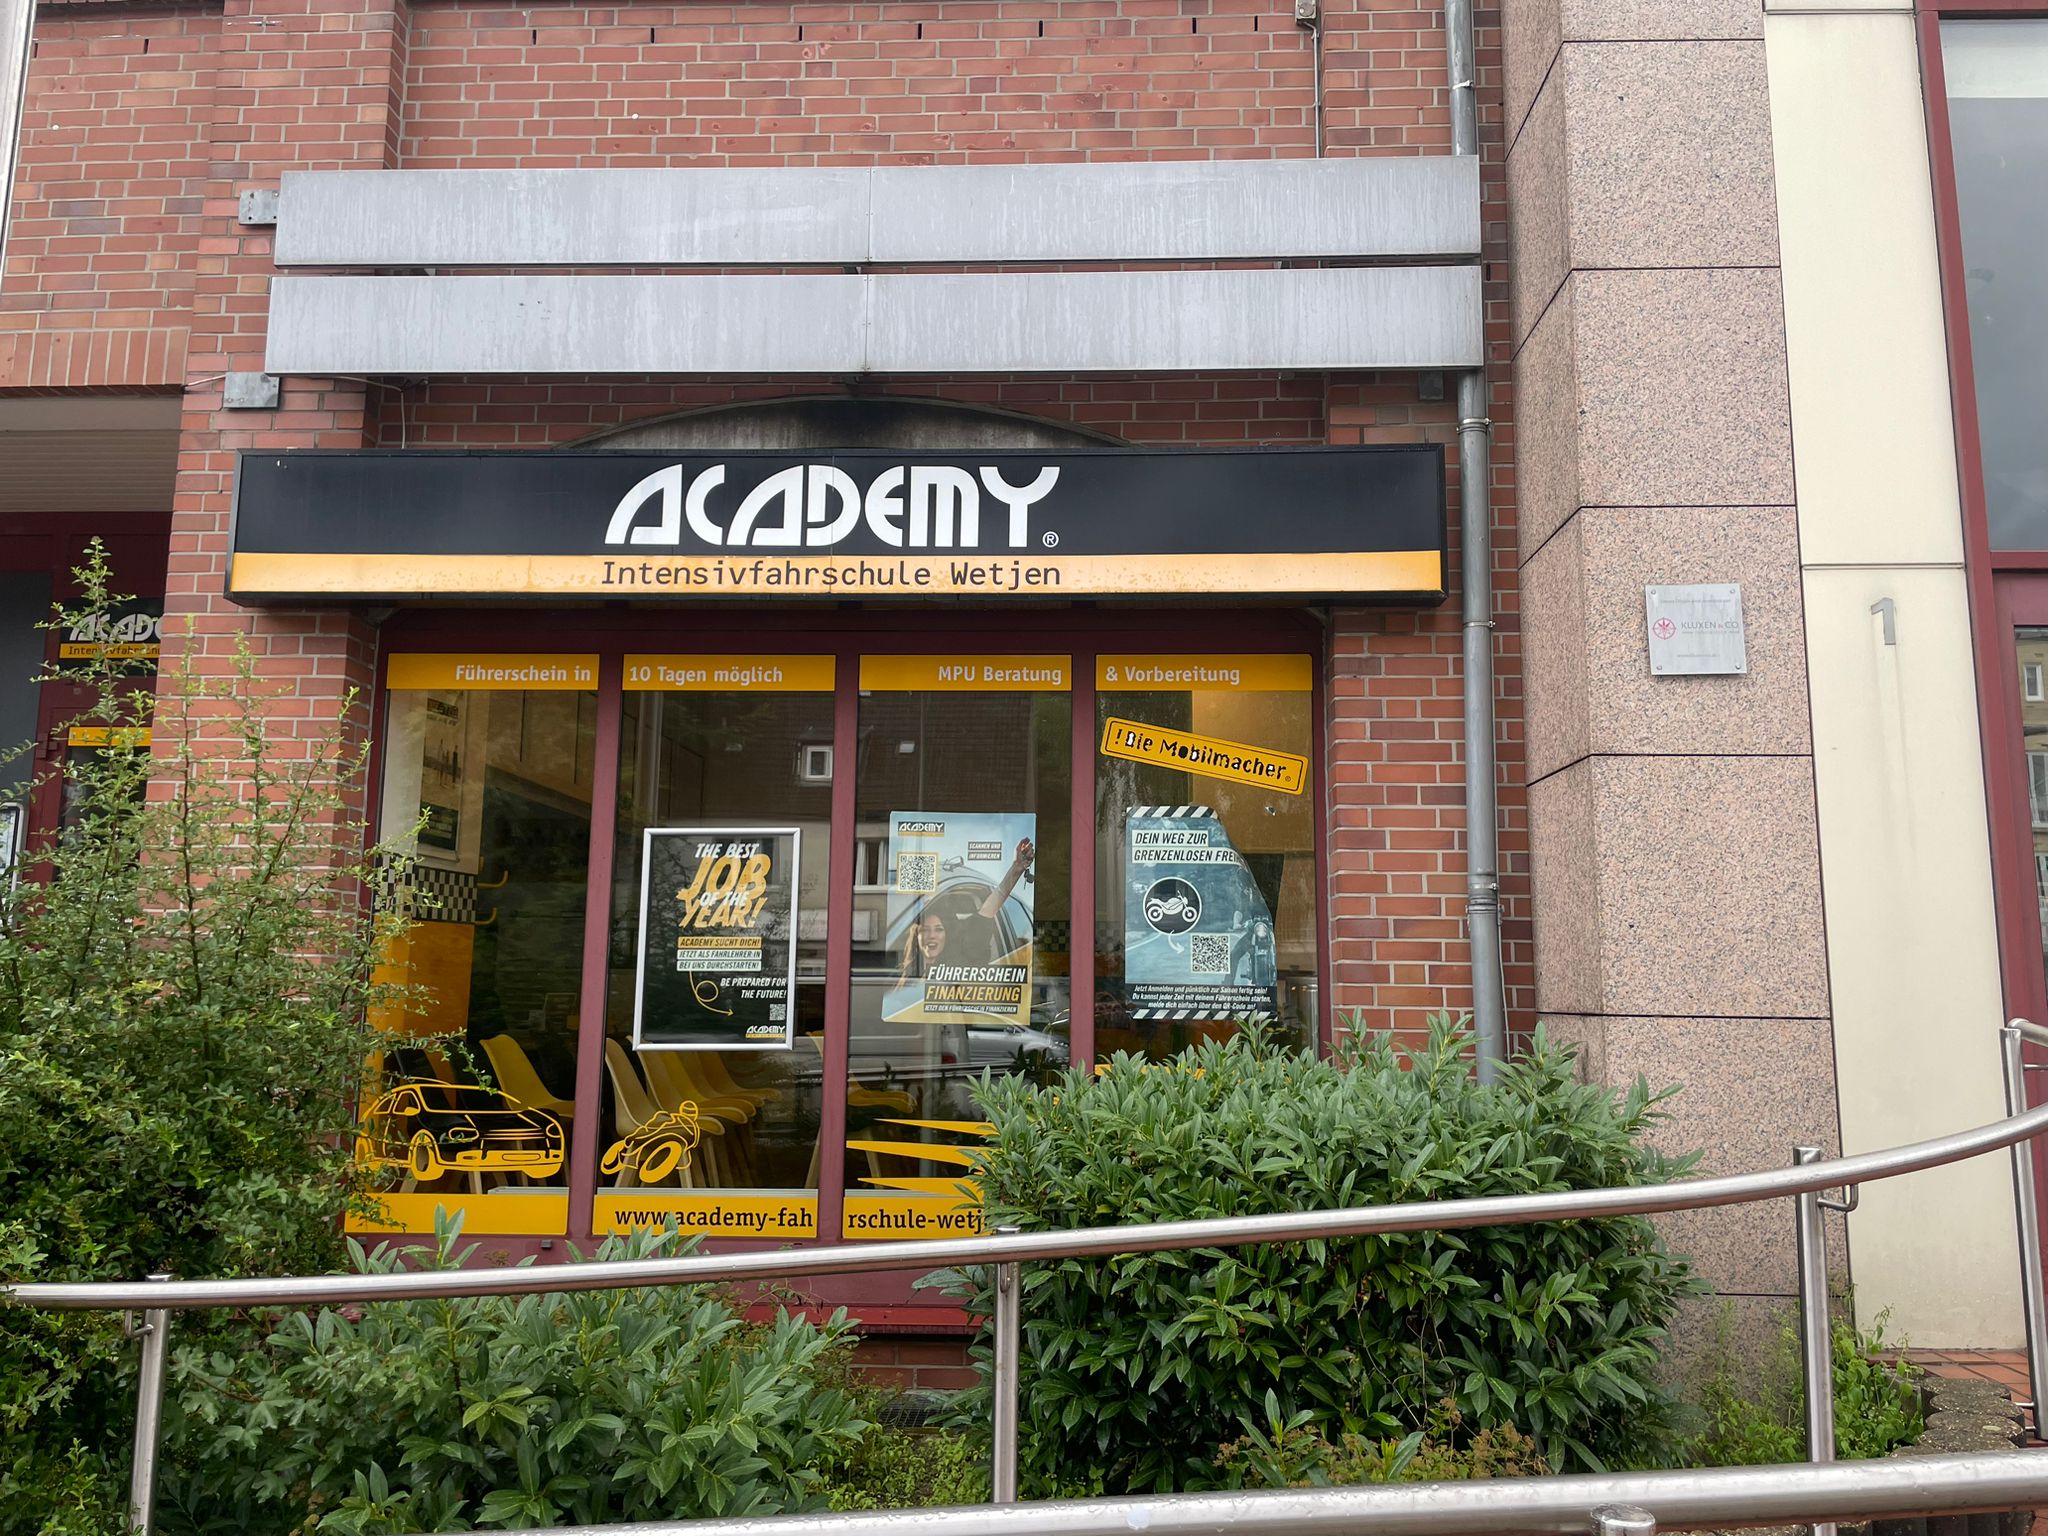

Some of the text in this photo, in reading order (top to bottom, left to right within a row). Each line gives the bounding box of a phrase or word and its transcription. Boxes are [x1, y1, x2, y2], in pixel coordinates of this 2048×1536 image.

[604, 463, 1061, 548] ACADEMY
[602, 560, 1061, 591] Intensivfahrschule Wetjen
[1870, 597, 1896, 645] 1
[455, 664, 591, 683] Führerschein in
[629, 665, 783, 688] 10 Tagen möglich
[938, 666, 1063, 688] MPU Beratung
[1105, 666, 1241, 688] & Vorbereitung
[1159, 738, 1288, 780] Mobilmacher
[899, 822, 944, 832] ACADEMY
[1135, 832, 1208, 844] DEIN WEG ZUR
[694, 843, 760, 859] THE BEST
[1134, 849, 1213, 861] GRENZENLOSEN
[676, 853, 772, 900] JOB
[700, 891, 750, 907] OF THE
[678, 897, 768, 929] YEAR!
[680, 938, 760, 947] ACADEMY SUCHT DICH!
[679, 950, 698, 958] JETZT
[698, 950, 710, 958] ALS
[679, 961, 759, 969] BEI UNS DURCHSTARTEN!
[927, 963, 1026, 982] FÜHRERSCHEIN
[720, 977, 787, 986] BE PREPARED FOR
[740, 989, 787, 998] THE FUTURE!
[926, 985, 1020, 1002] FINANZIERUNG
[746, 1025, 786, 1034] ACADEMY
